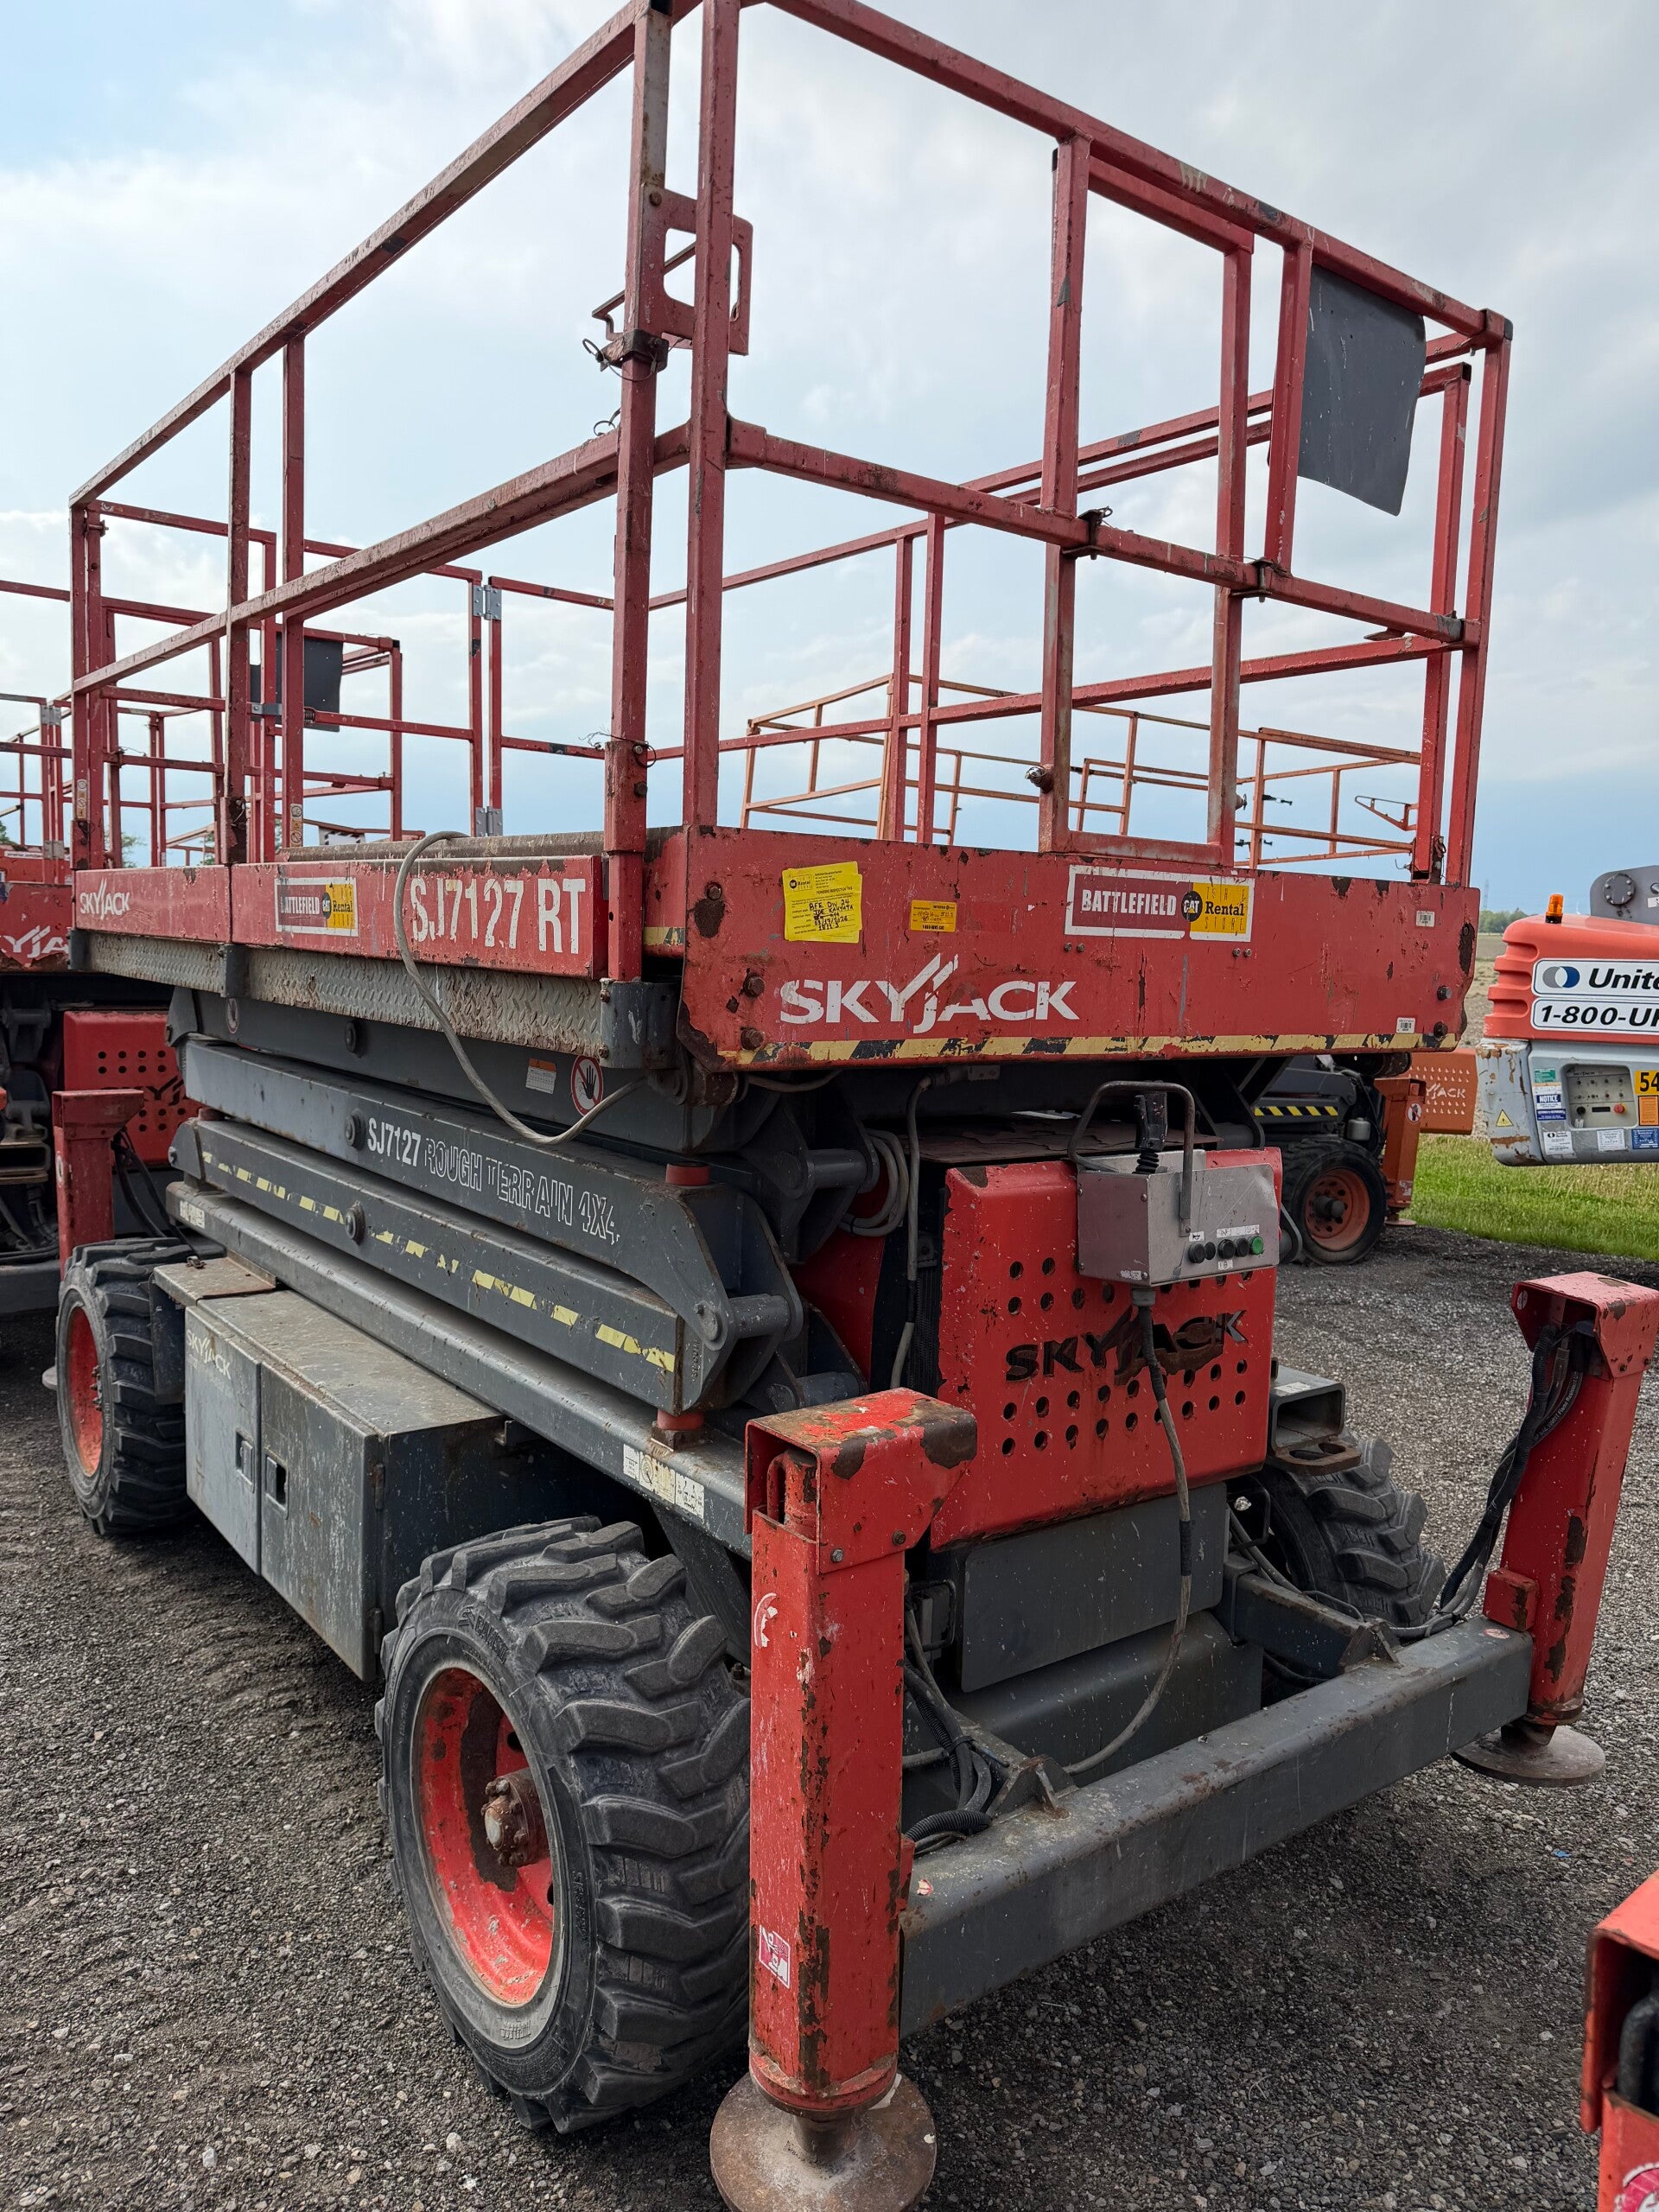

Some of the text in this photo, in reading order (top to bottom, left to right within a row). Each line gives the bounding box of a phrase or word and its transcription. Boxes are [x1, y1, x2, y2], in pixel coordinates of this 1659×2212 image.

[79, 878, 130, 920] SKYJACK
[333, 900, 353, 912] Rental
[410, 878, 586, 954] SJ7127 RT
[1082, 889, 1244, 917] BATTLEFIELD CAT Rental
[780, 952, 1080, 1034] SKYJACK
[1539, 1095, 1559, 1103] NOTICE
[367, 1117, 421, 1166] SJ7127
[425, 1137, 483, 1192] ROUGH
[486, 1156, 574, 1226] TERRAIN
